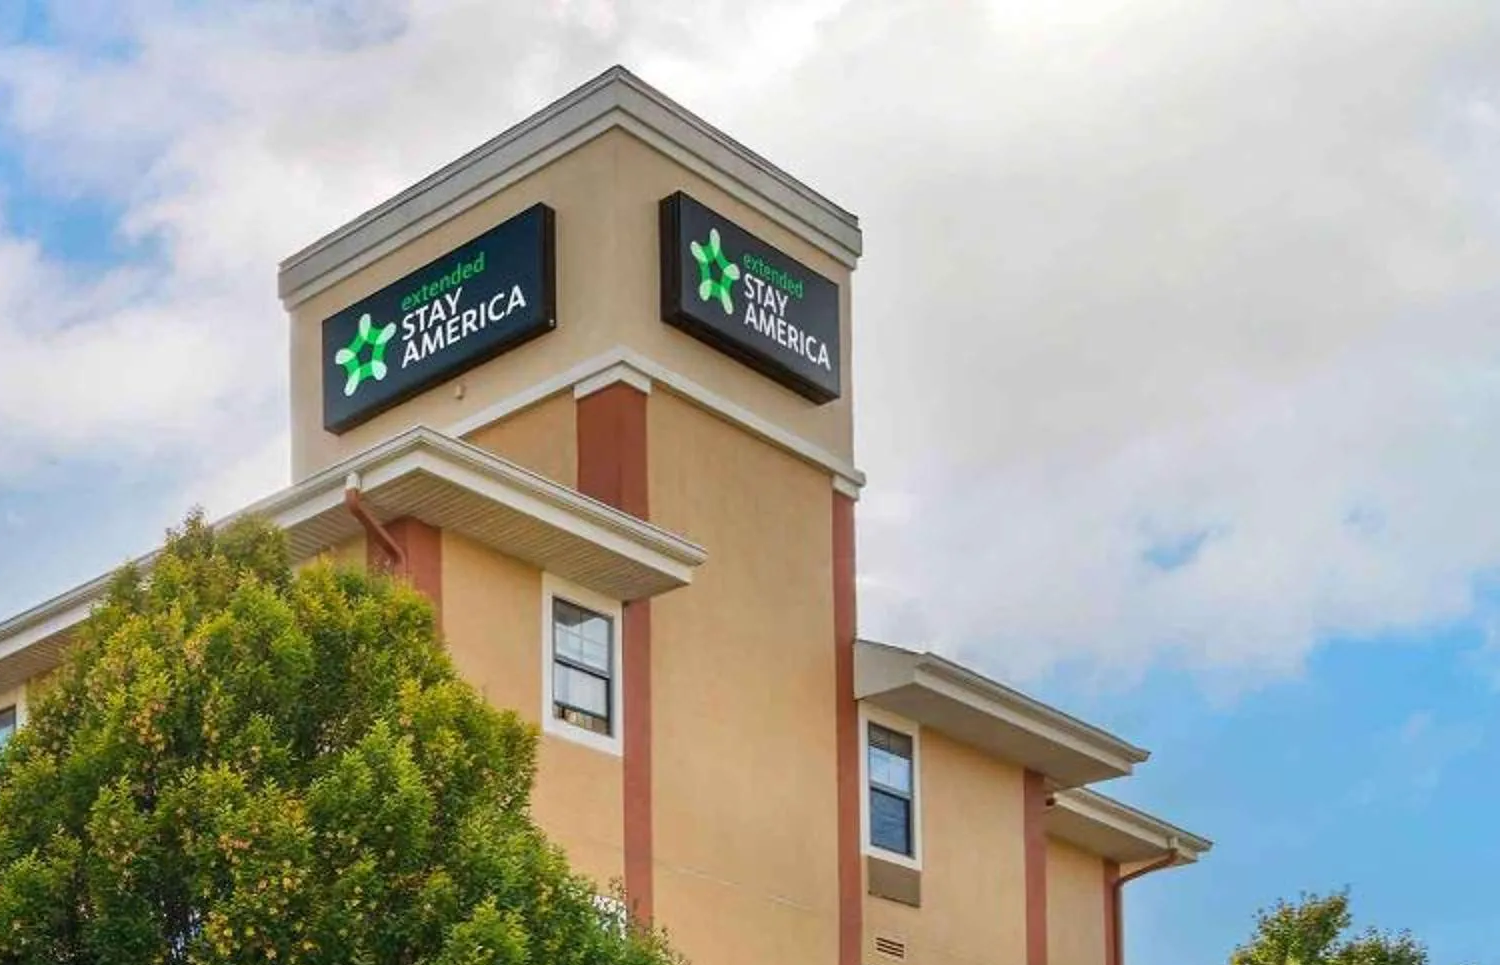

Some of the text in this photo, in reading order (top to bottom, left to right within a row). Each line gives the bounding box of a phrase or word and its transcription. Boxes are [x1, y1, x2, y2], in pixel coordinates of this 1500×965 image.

[402, 251, 485, 311] extended
[743, 253, 803, 299] extended
[744, 273, 788, 317] STAY
[401, 284, 526, 369] AMERICA
[402, 286, 462, 341] STAY
[743, 302, 832, 371] AMERICA
